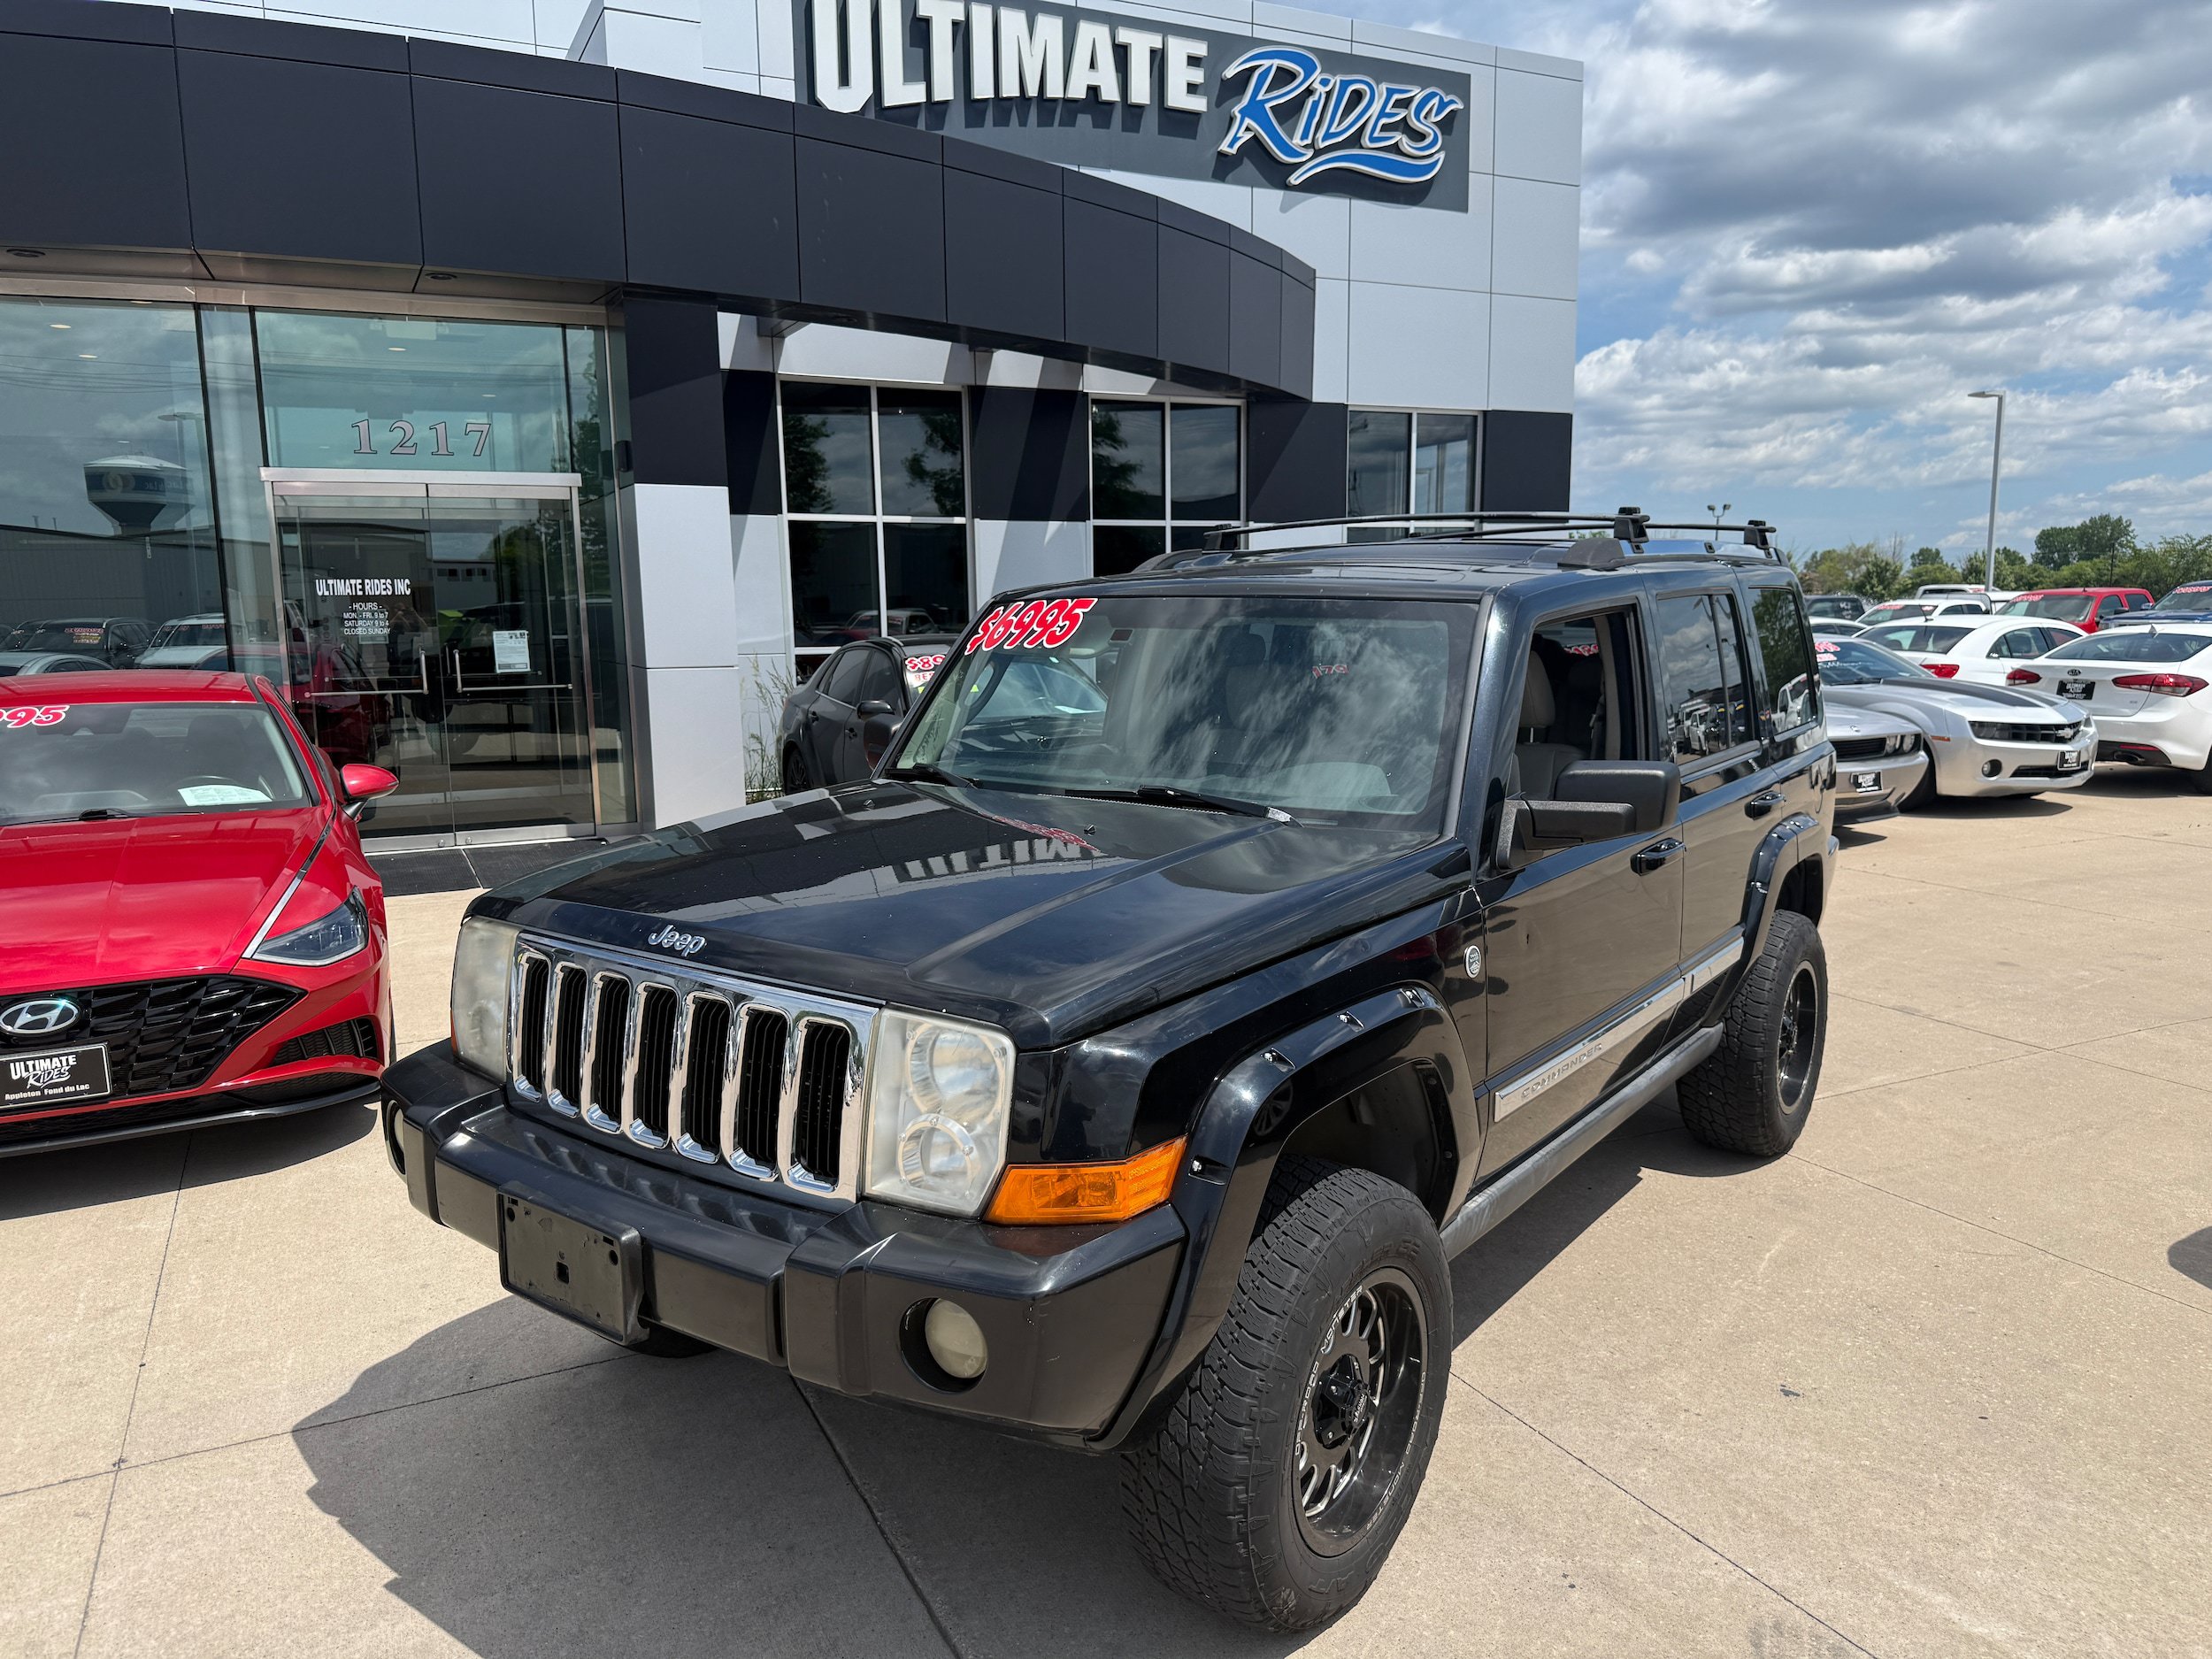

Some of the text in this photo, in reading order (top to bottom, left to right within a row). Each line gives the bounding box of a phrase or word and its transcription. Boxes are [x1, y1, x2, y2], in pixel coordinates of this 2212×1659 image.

[812, 0, 1209, 113] ULTIMATE
[351, 419, 491, 457] 1217
[315, 579, 411, 596] ULTIMATE RIDES INC
[964, 597, 1098, 656] $6995
[0, 704, 70, 728] 95
[648, 925, 706, 957] Jeep
[10, 1055, 77, 1080] ULTIMATE
[1522, 1042, 1602, 1098] COMMANDER
[4, 1089, 42, 1101] Appleton
[43, 1087, 64, 1095] Fond
[1320, 1285, 1363, 1354] MONSTER
